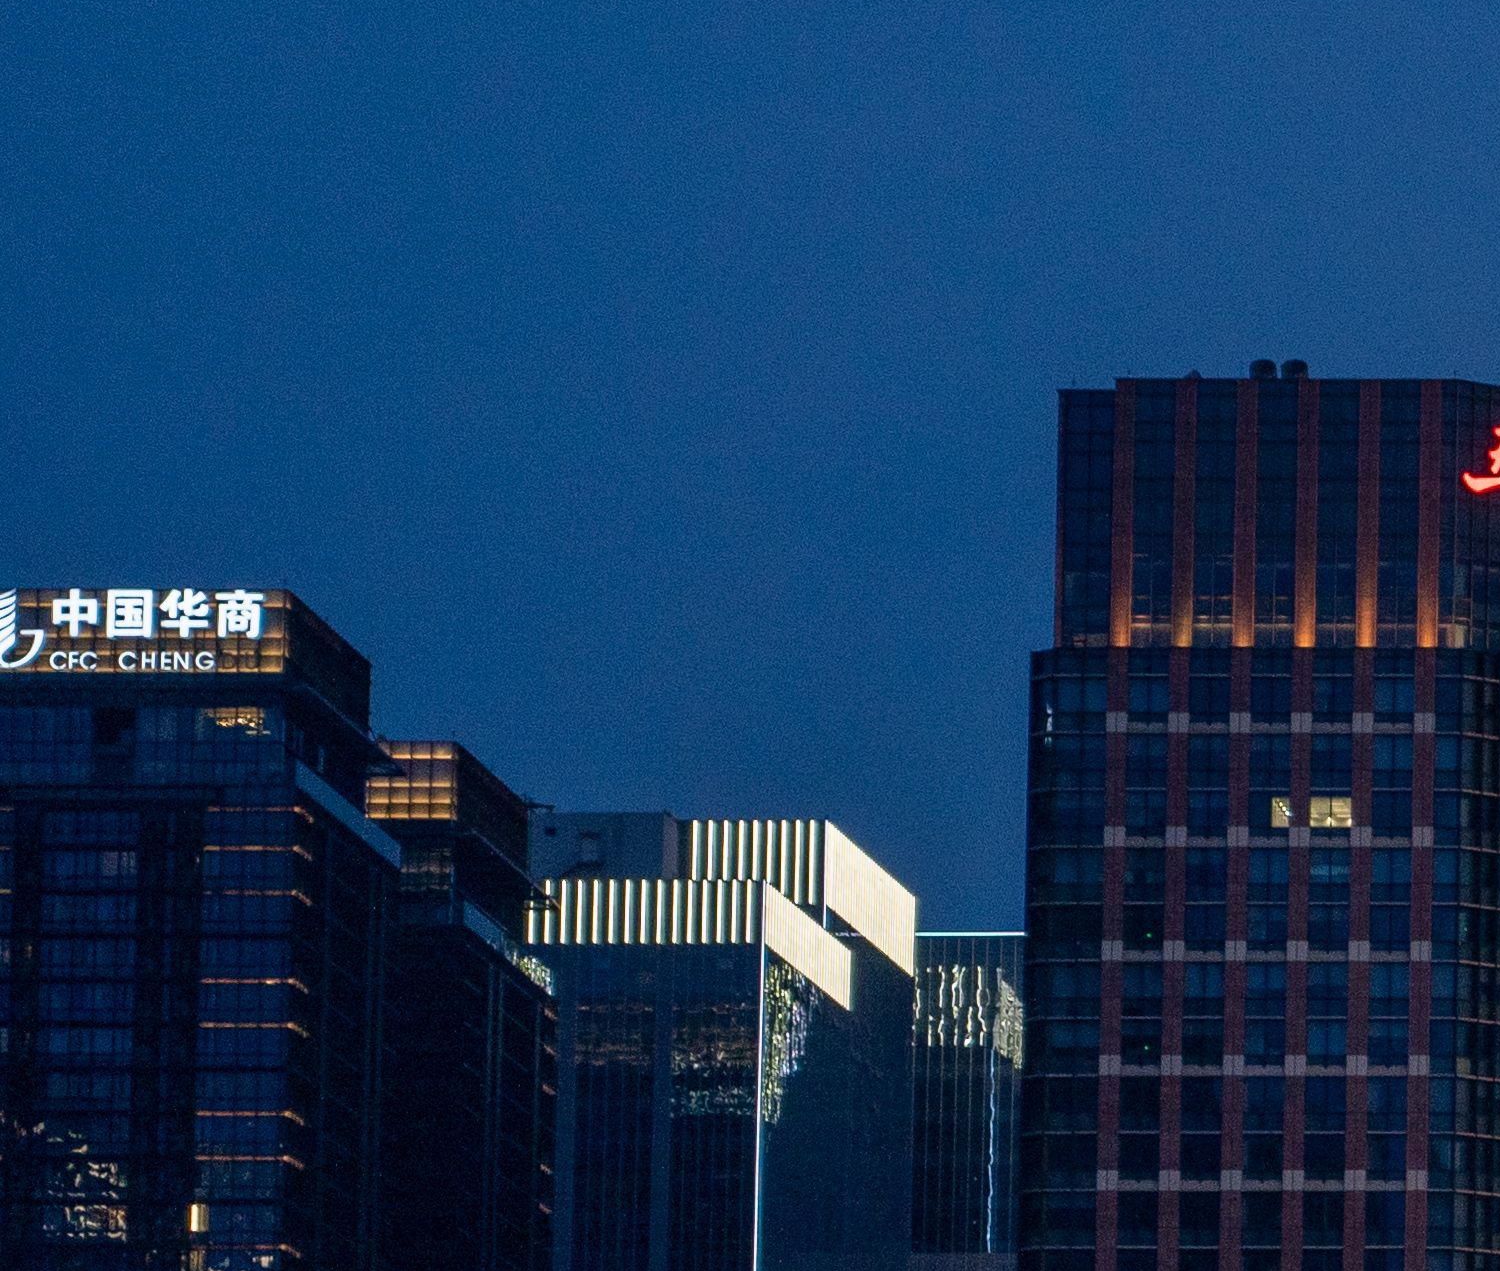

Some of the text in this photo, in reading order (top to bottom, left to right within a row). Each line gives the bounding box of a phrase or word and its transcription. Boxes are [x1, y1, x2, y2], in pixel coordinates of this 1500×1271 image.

[52, 589, 264, 638] 中国华商
[50, 651, 97, 670] CFC
